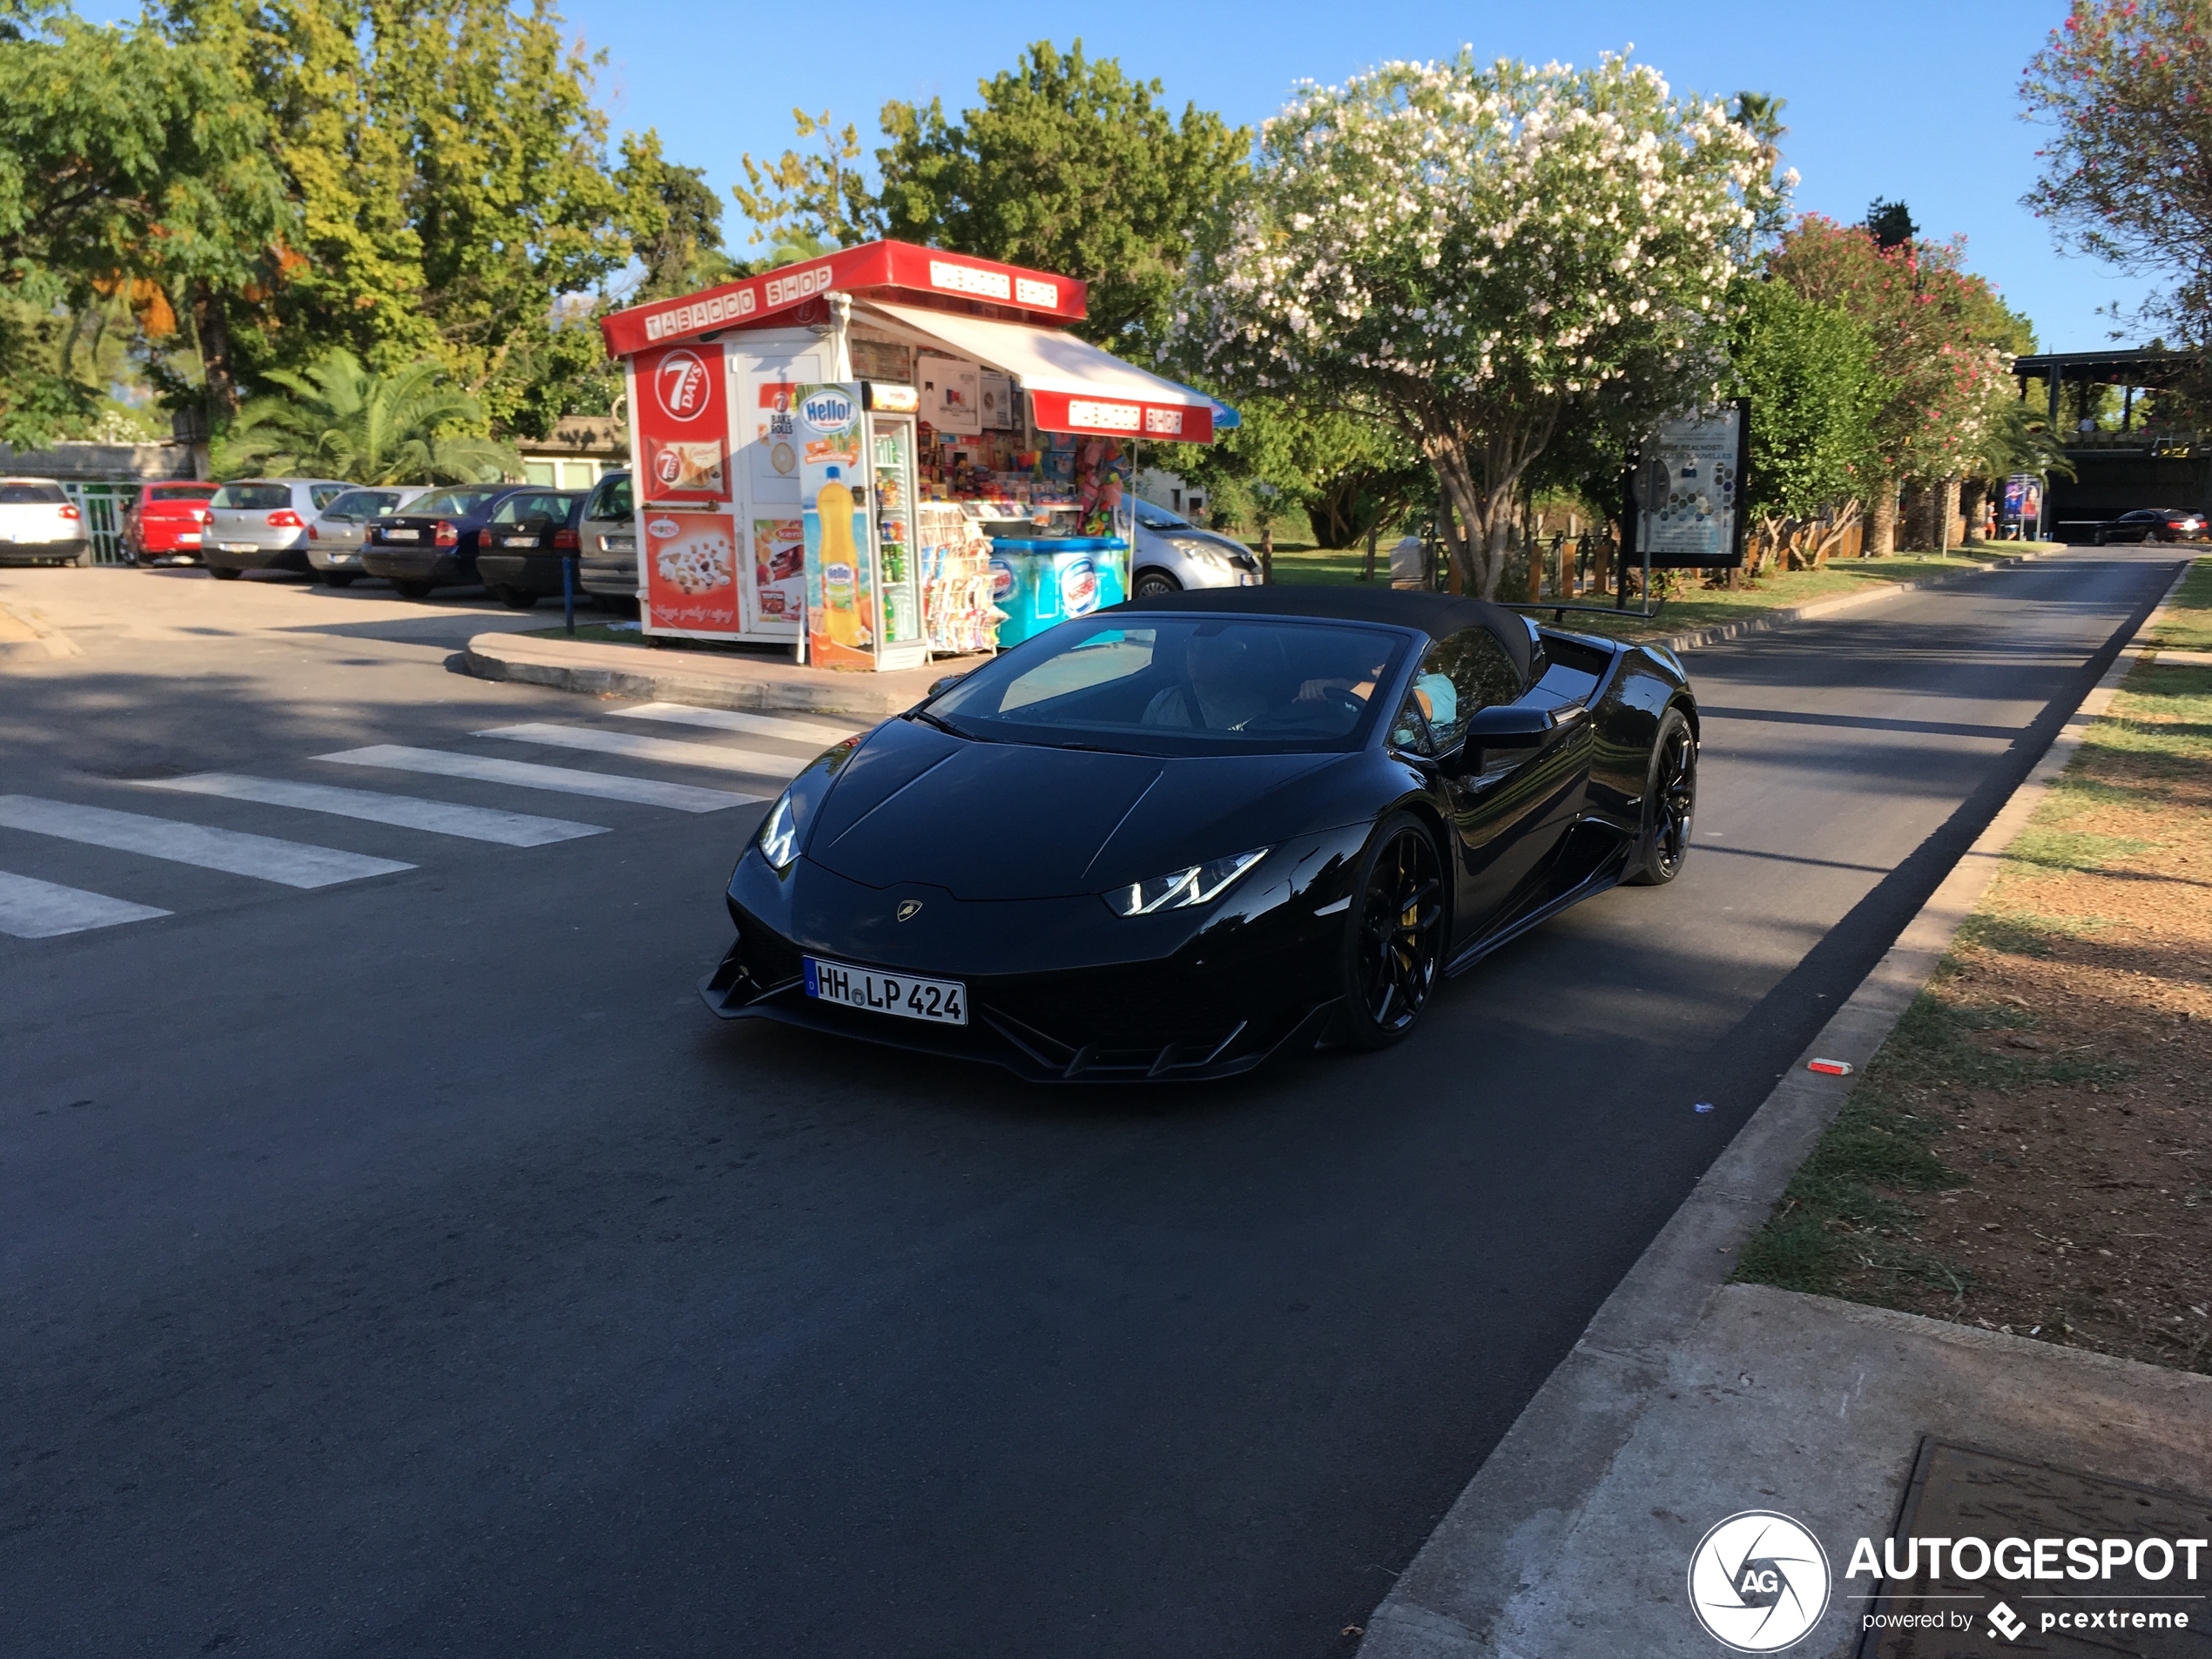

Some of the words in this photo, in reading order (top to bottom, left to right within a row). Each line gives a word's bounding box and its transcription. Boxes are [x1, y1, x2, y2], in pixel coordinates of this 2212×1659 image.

[646, 288, 756, 340] TABACCO
[765, 266, 833, 307] SHOP
[665, 361, 694, 410] 7
[682, 365, 702, 408] DAYS
[806, 400, 851, 421] Hello!
[1146, 408, 1183, 435] SHOP
[659, 455, 674, 479] 7
[808, 981, 815, 990] D
[818, 965, 850, 1001] HH
[867, 976, 900, 1010] LP
[907, 984, 961, 1019] 424
